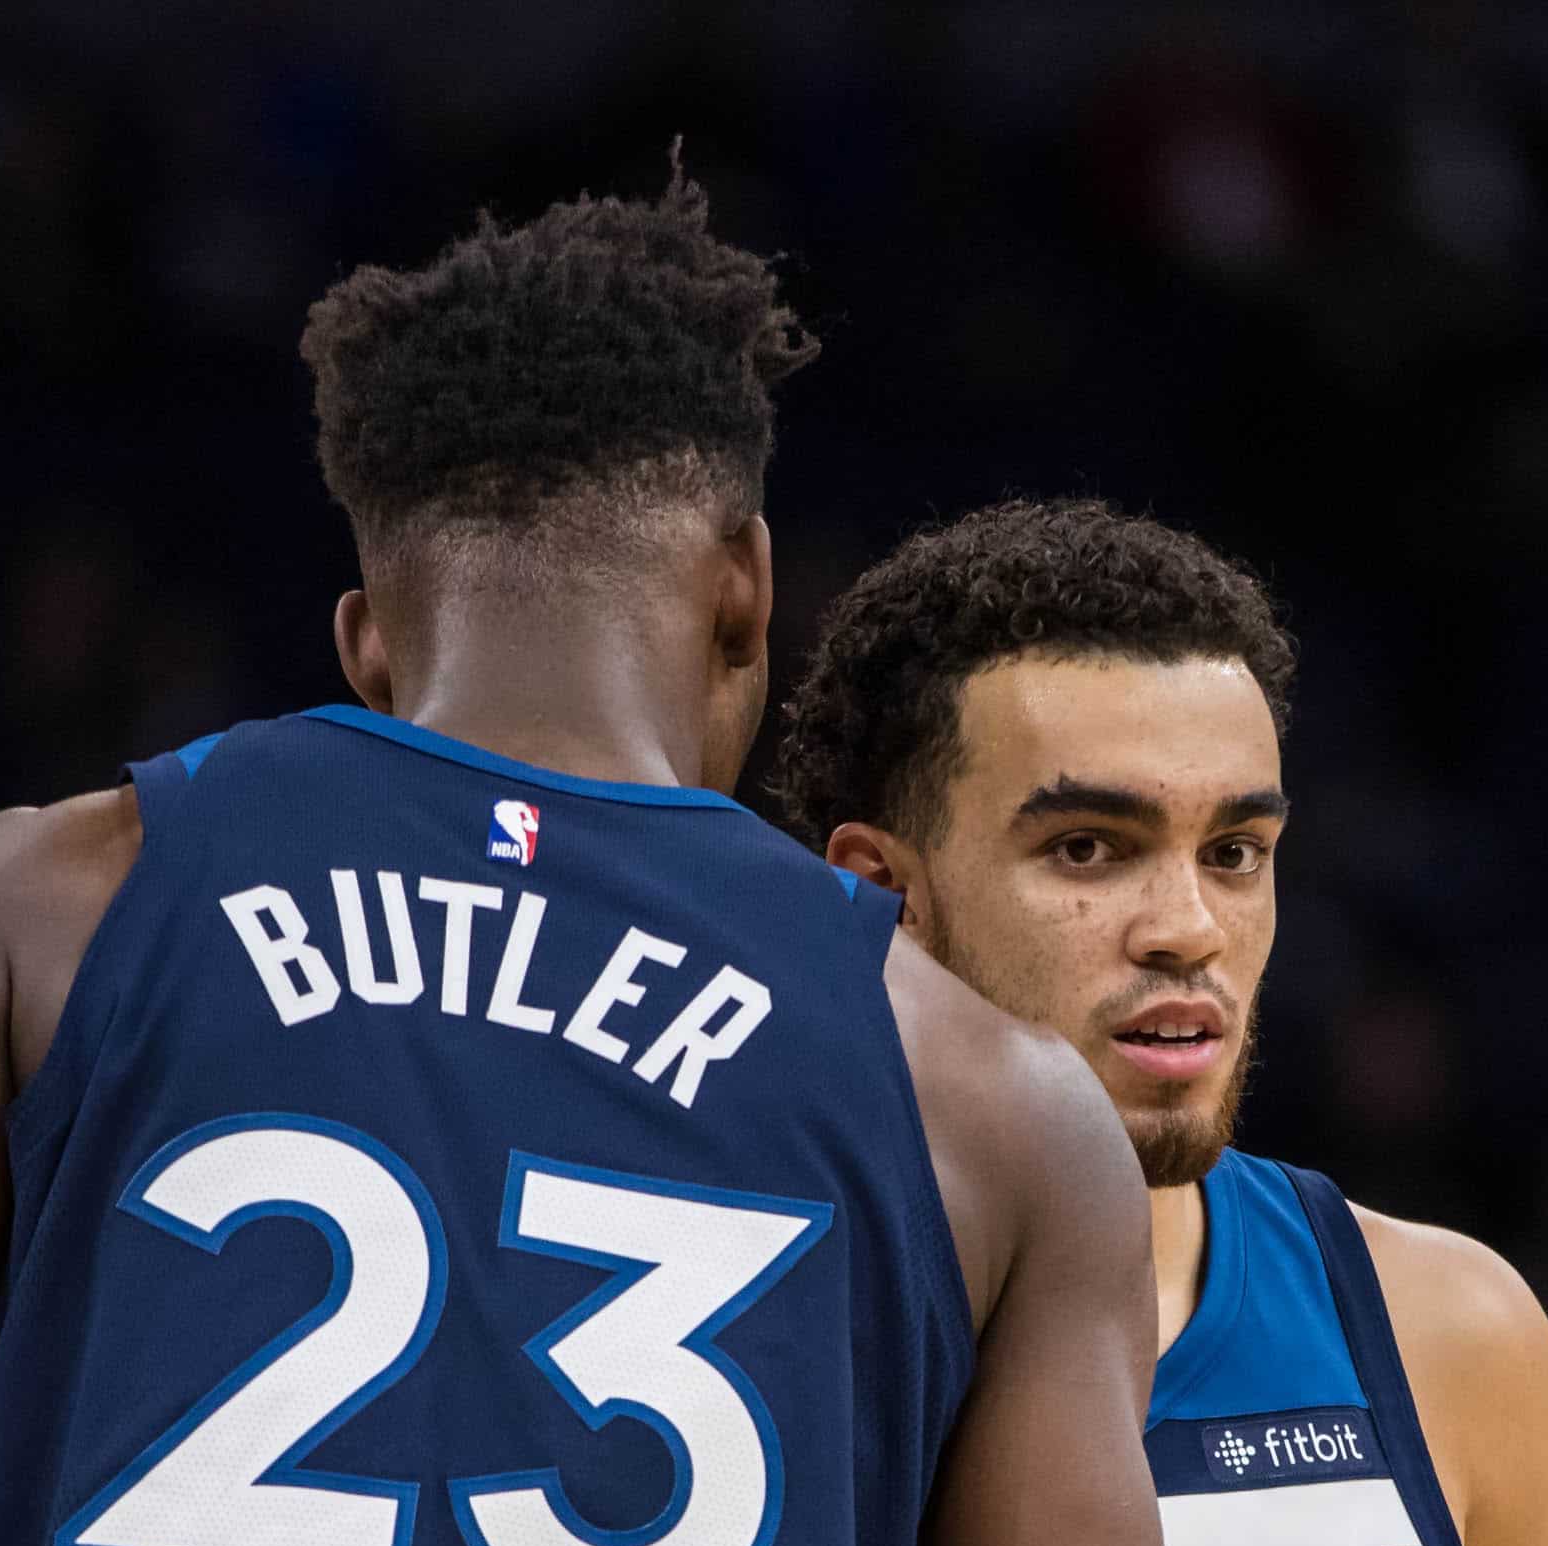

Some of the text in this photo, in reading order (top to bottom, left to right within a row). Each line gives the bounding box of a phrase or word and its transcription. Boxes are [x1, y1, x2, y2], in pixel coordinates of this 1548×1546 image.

[491, 841, 521, 860] NBA
[219, 868, 772, 1109] BUTLER
[1264, 1422, 1364, 1468] fitbit
